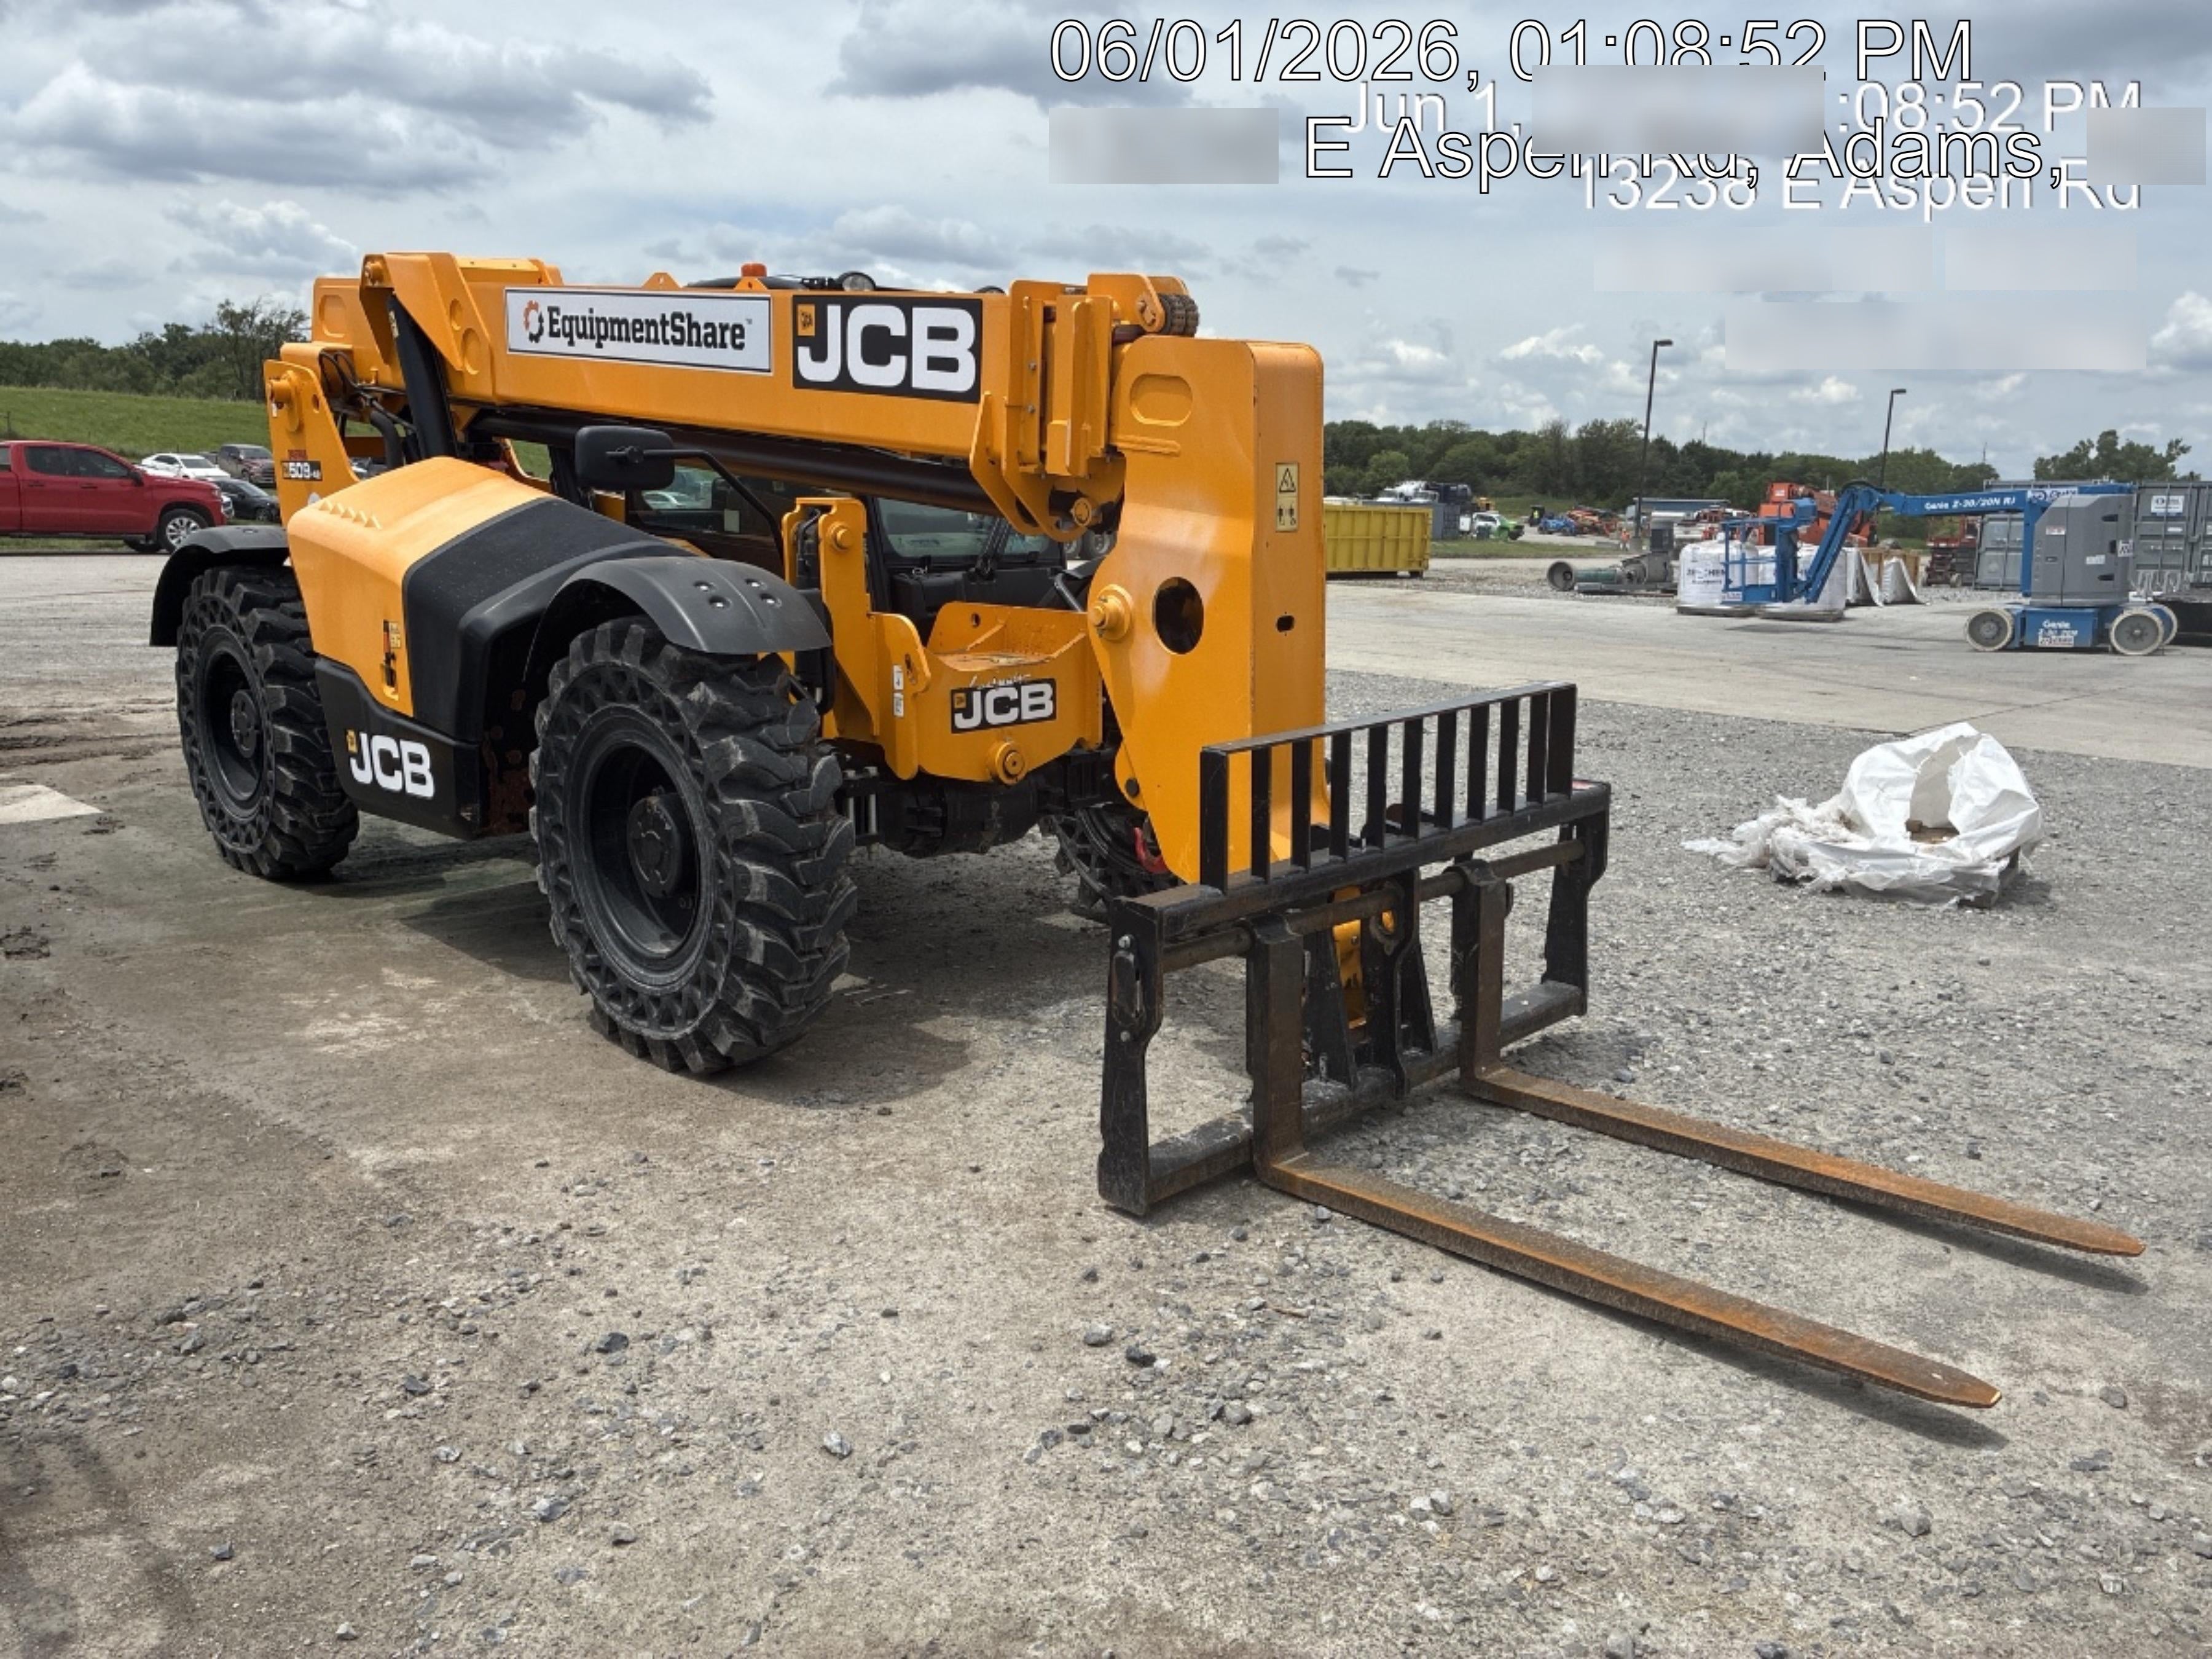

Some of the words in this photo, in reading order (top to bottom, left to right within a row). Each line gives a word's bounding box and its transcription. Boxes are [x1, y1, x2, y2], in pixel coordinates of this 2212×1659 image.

[547, 305, 745, 351] EquipmentShare
[798, 304, 976, 393] JCB
[954, 683, 1054, 729] JCB
[350, 733, 434, 799] JCB
